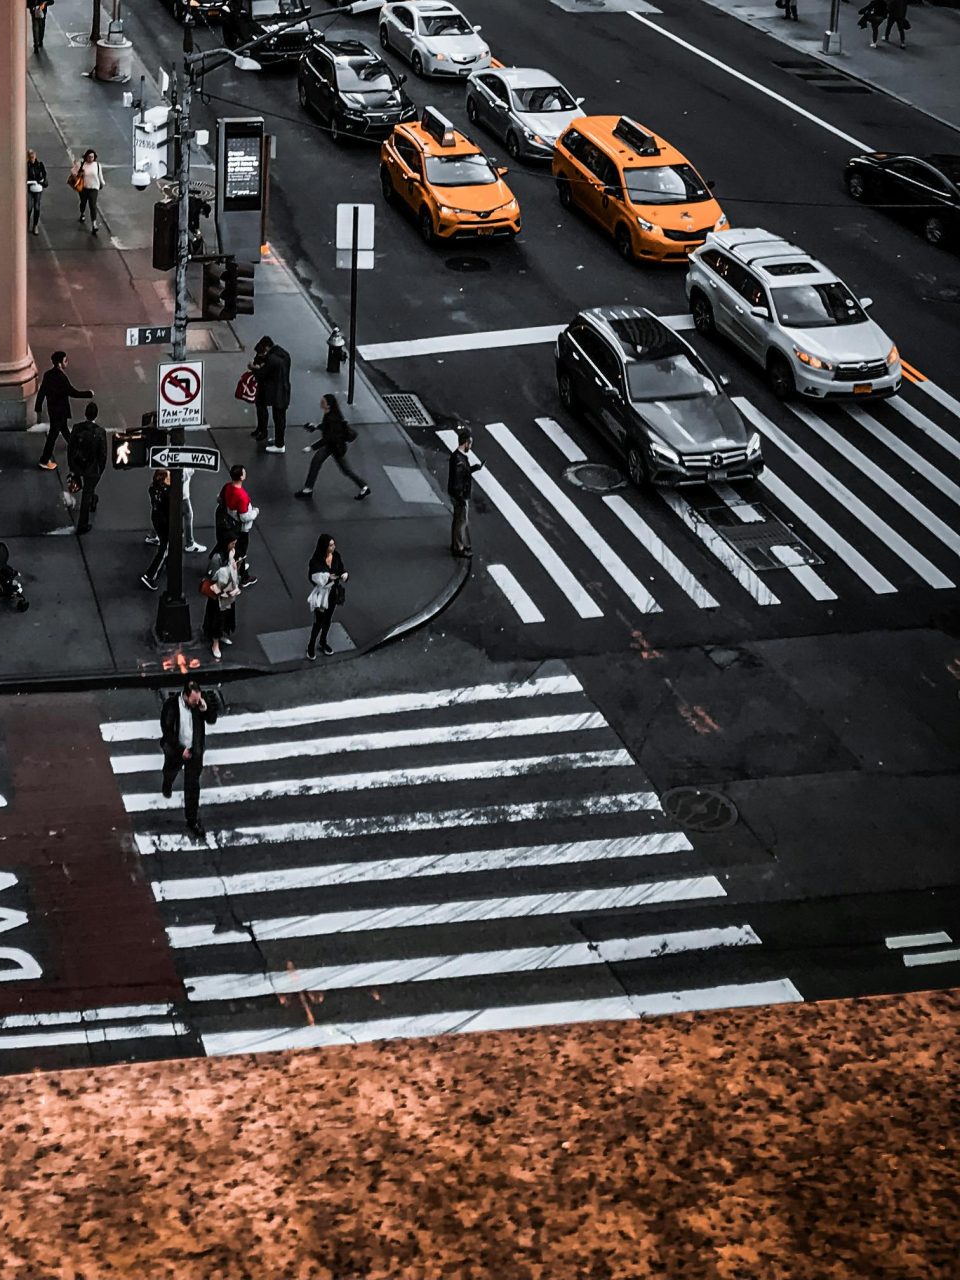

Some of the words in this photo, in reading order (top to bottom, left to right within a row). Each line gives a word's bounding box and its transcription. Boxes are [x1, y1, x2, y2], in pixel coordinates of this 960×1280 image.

[145, 330, 152, 343] 5
[160, 453, 180, 462] ONE
[191, 454, 213, 463] WAY
